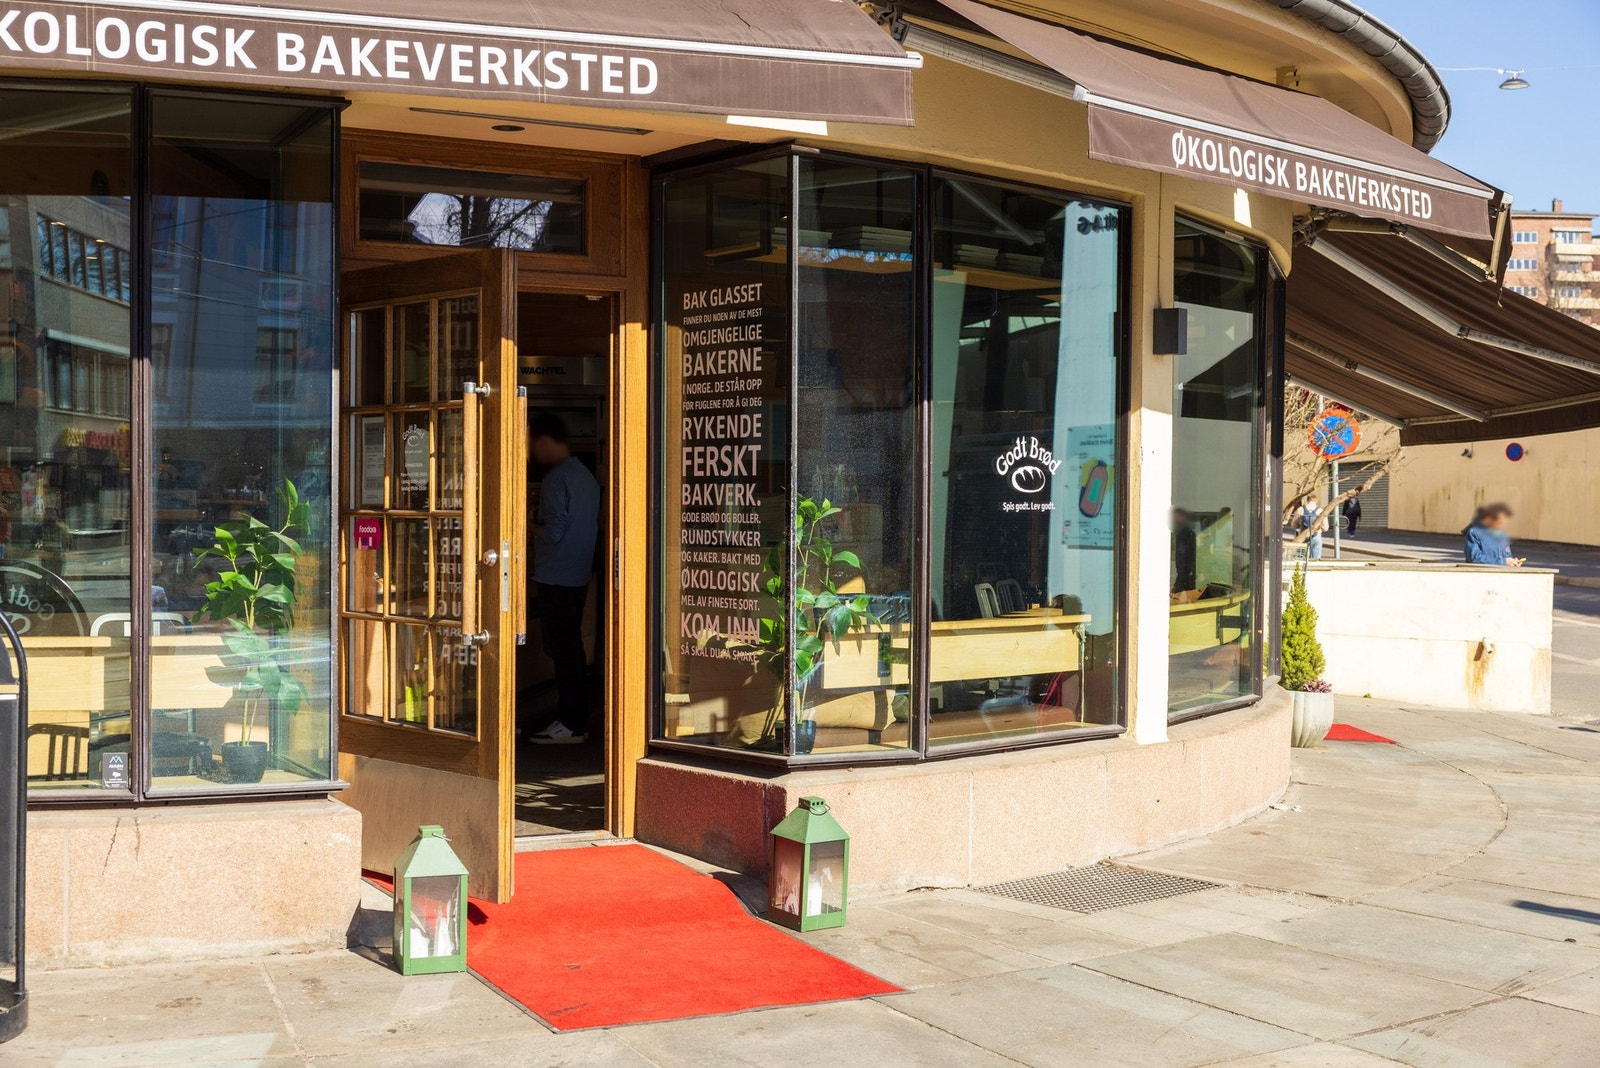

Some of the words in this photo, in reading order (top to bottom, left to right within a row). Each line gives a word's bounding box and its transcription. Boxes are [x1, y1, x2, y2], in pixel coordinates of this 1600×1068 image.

[277, 32, 659, 96] BAKEVERKSTED
[1171, 129, 1290, 188] ØKOLOGISK
[1295, 161, 1432, 220] BAKEVERKSTED
[683, 290, 708, 310] BAK
[710, 282, 763, 307] GLASSET
[683, 313, 703, 325] FINNER
[703, 313, 712, 323] DU
[712, 311, 728, 322] NOEN
[729, 310, 737, 320] AV
[738, 309, 746, 320] DE
[746, 307, 763, 319] MEST
[683, 324, 763, 347] OMGJENGELIGE
[519, 366, 567, 375] WACHTEL
[682, 347, 762, 377] BAKERNE
[686, 381, 714, 395] NORGE.
[714, 381, 725, 393] DE
[726, 376, 745, 392] STÅR
[746, 378, 762, 391] OPP
[683, 400, 694, 411] FØR
[695, 398, 721, 410] FUGLENE
[722, 398, 734, 408] FOR
[735, 396, 741, 408] Å
[741, 397, 749, 407] GI
[749, 396, 762, 407] DEG
[682, 413, 762, 440] RYKENDE
[681, 444, 761, 477] FERSKT
[996, 435, 1027, 476] Godt
[1029, 436, 1062, 476] Brød
[681, 483, 761, 506] BAKVERK.
[681, 512, 700, 523] GODE
[700, 512, 720, 524] BRØD
[721, 512, 731, 523] OG
[732, 513, 761, 524] BOLLER.
[1002, 501, 1015, 512] Spis
[1015, 501, 1030, 513] godt.
[1031, 502, 1040, 511] Lev
[1041, 502, 1056, 513] godt.
[681, 529, 761, 547] RUNDSTYKKER
[681, 550, 692, 562] OG
[693, 551, 720, 564] KAKER.
[721, 552, 742, 565] BAKT
[743, 553, 761, 566] MED
[681, 567, 760, 593] ØKOLOGISK
[681, 594, 695, 606] MEL
[697, 596, 707, 607] AV
[707, 596, 737, 609] FINESTE
[738, 598, 760, 611] SORT.
[681, 612, 720, 641] KOM
[727, 615, 760, 645] INN
[680, 642, 690, 655] SÅ
[691, 647, 709, 657] SKAL
